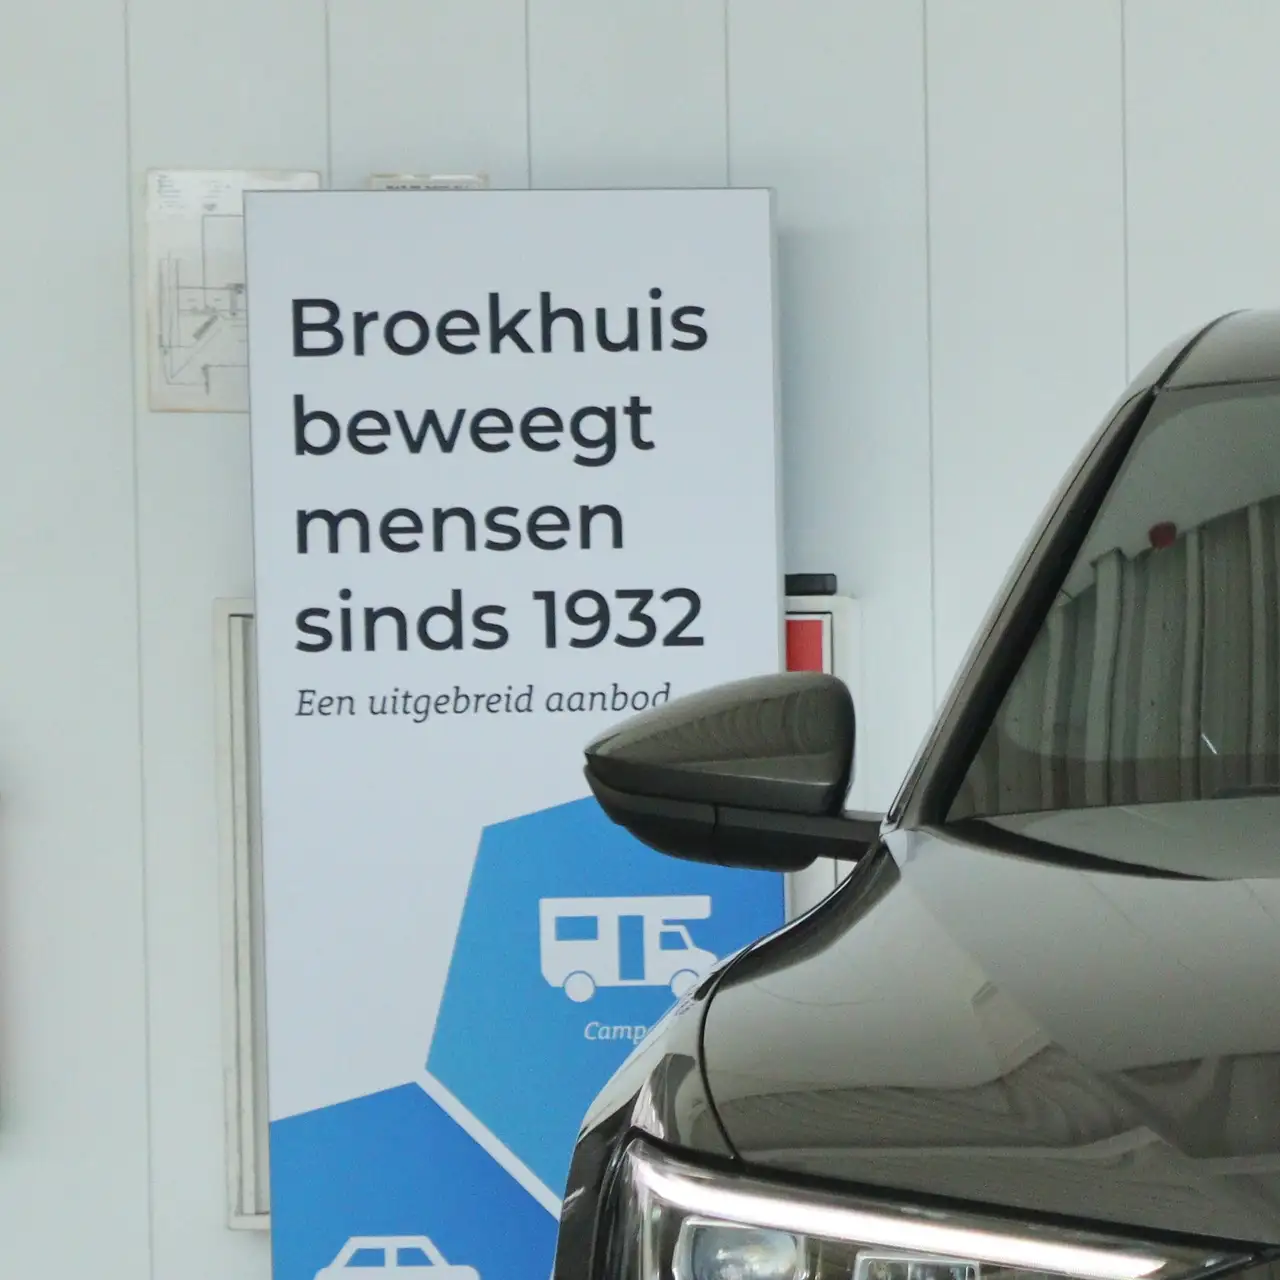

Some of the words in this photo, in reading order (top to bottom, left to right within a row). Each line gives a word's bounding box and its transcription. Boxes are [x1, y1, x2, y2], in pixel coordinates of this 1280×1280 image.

[292, 287, 708, 357] Broekhuis
[293, 394, 656, 467] beweegt
[296, 504, 624, 554] mensen
[295, 588, 510, 652] sinds
[532, 587, 705, 649] 1932
[295, 688, 356, 716] Een
[368, 684, 535, 724] uitgebreid
[545, 682, 672, 714] aanbod
[584, 1021, 648, 1046] Camp
